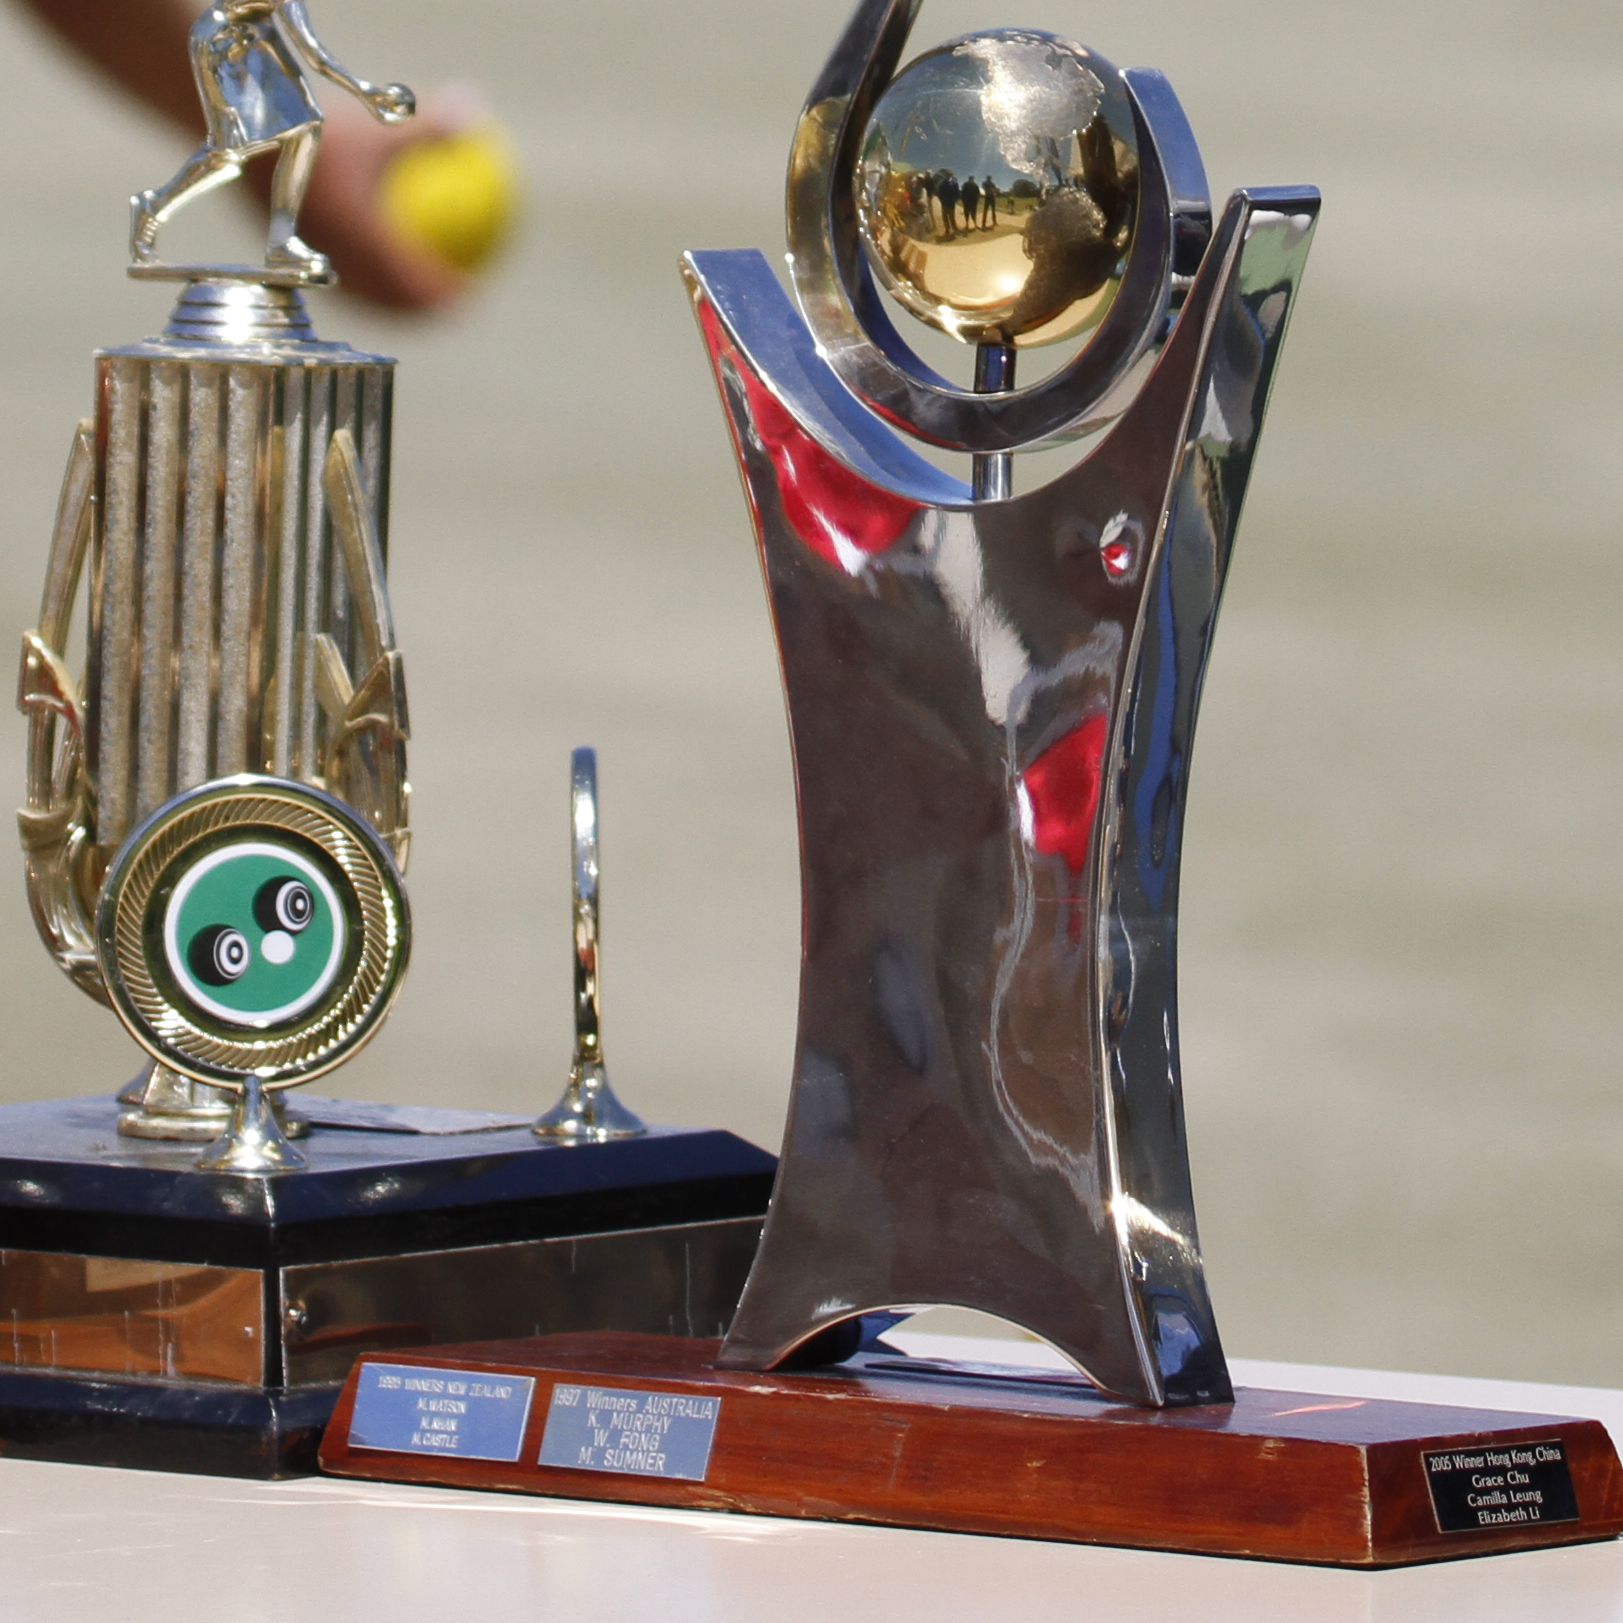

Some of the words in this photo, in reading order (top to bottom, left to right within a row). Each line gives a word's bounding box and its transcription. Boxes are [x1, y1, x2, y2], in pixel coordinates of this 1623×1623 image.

[404, 1378, 445, 1393] WINNERS
[446, 1381, 468, 1396] NEW
[468, 1383, 513, 1399] ZEALAND
[554, 1388, 581, 1407] 1997
[586, 1390, 638, 1412] Winners
[643, 1396, 714, 1419] AUSTRALIA
[587, 1410, 601, 1428] K.
[610, 1412, 672, 1434] MURPHY
[593, 1428, 611, 1448] W.
[619, 1431, 661, 1451] FONG
[577, 1446, 594, 1465] M.
[604, 1449, 666, 1471] SUMNER
[1429, 1455, 1452, 1472] 2005
[1452, 1454, 1485, 1469] Winner
[1485, 1451, 1512, 1468] Hong
[1511, 1449, 1536, 1466] Kong,
[1536, 1446, 1562, 1462] China
[1472, 1474, 1505, 1488] Grace
[1507, 1470, 1530, 1484] Chu
[1467, 1490, 1508, 1507] Camilla
[1510, 1490, 1543, 1503] Leung
[1477, 1507, 1527, 1525] Elizabeth
[1529, 1506, 1541, 1520] Li
